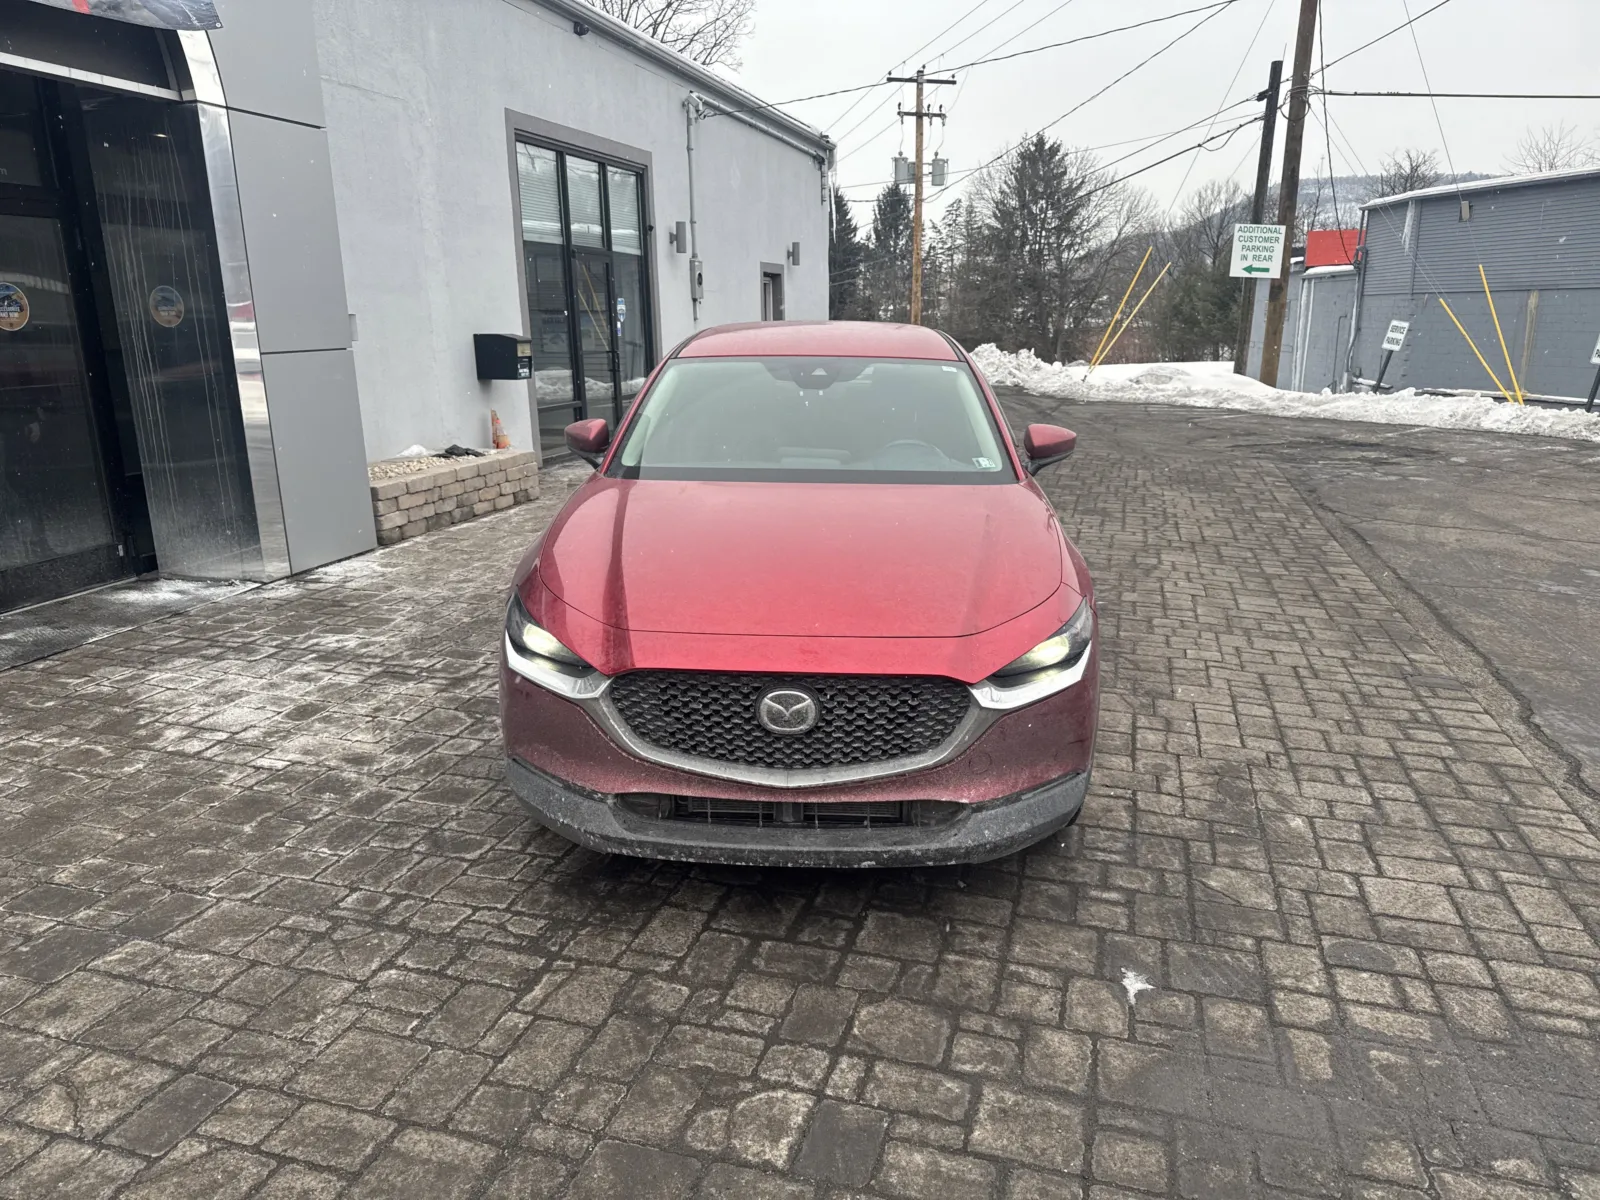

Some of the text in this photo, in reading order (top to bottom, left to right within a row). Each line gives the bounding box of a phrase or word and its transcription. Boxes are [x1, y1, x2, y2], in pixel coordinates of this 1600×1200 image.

[1237, 226, 1283, 235] ADDITIONAL
[1238, 235, 1280, 244] CUSTOMER
[1241, 244, 1275, 253] PARKING
[1240, 254, 1273, 262] IN REAR
[1390, 325, 1406, 334] SERVICE
[1386, 336, 1402, 346] PARKING
